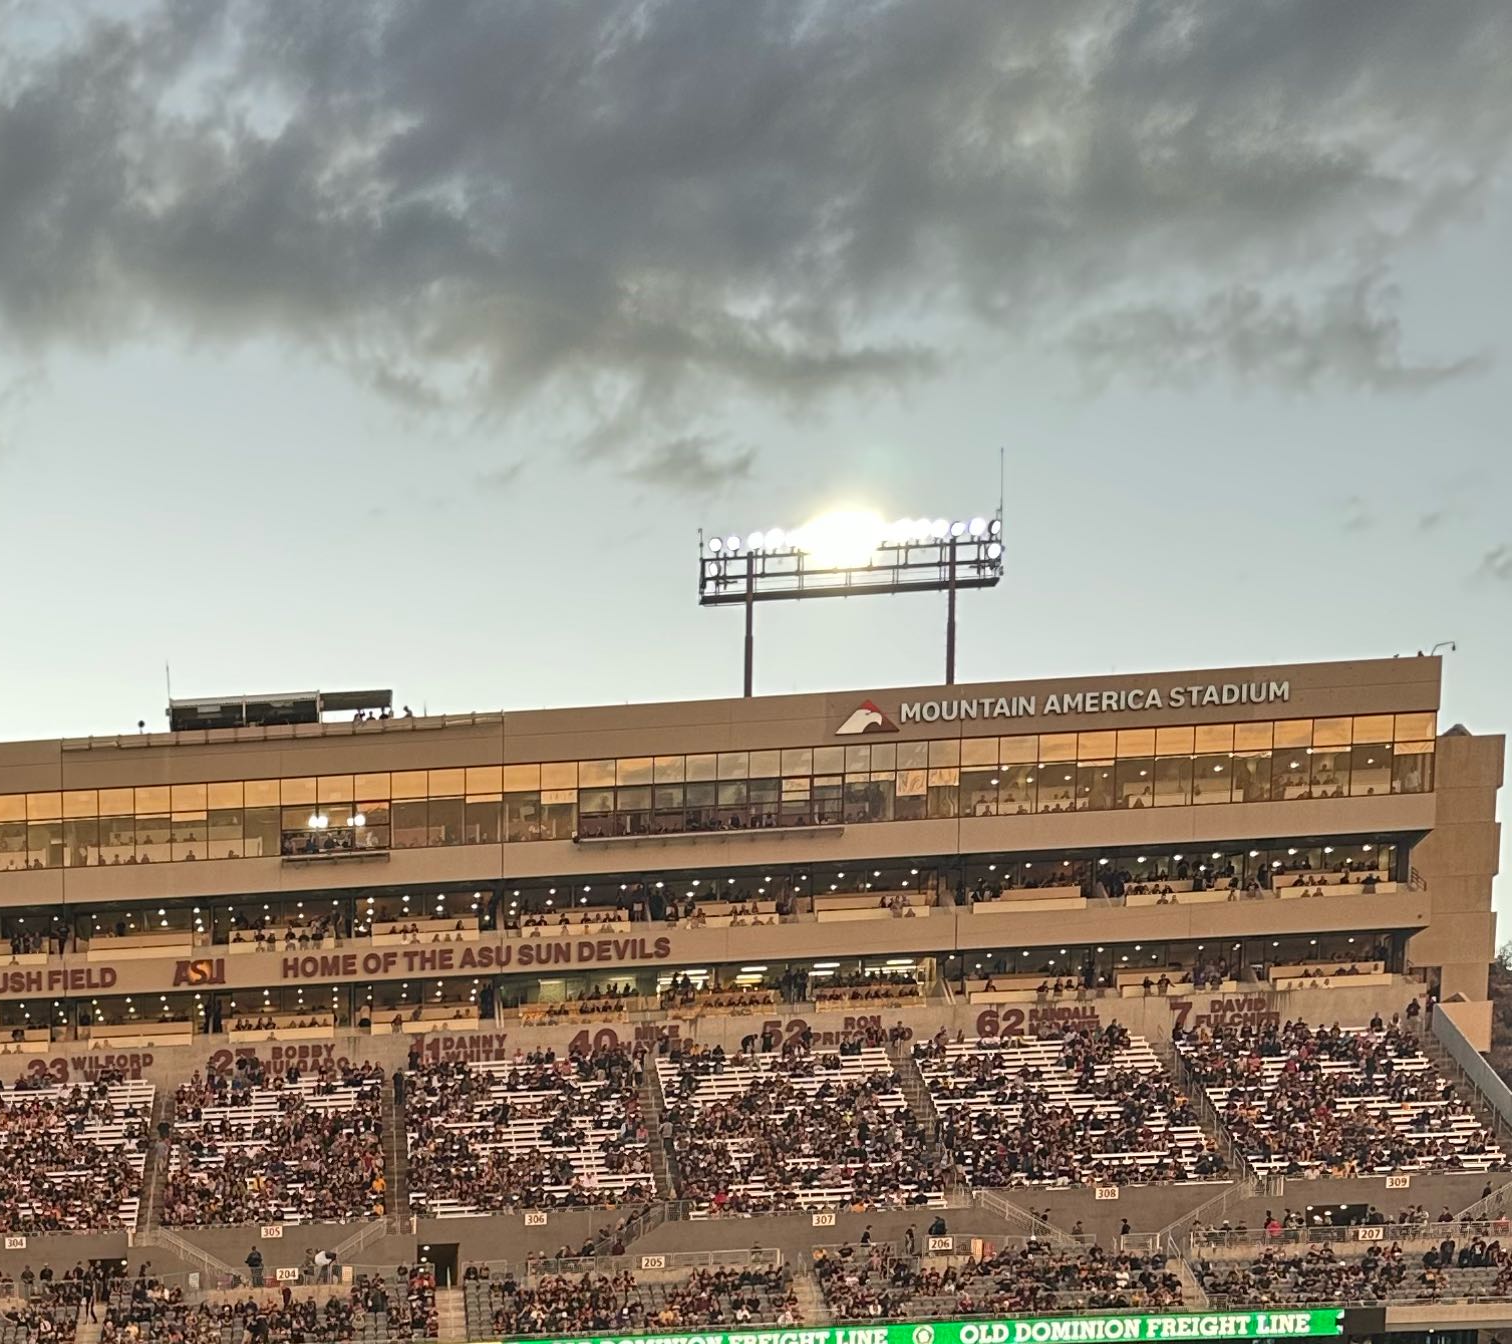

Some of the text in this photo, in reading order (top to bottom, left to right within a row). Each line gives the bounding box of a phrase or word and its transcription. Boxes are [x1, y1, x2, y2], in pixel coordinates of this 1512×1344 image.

[900, 681, 1290, 723] MOUNTAIN AMERICA STADIUM
[282, 937, 671, 979] HOME OF THE ASU SUN DEVILS
[47, 967, 117, 991] FIELD
[173, 958, 226, 986] ASU
[1210, 998, 1266, 1014] DAVID
[976, 1008, 1025, 1038] 62
[443, 1033, 507, 1050] DANNY
[271, 1044, 335, 1059] BOBBY
[71, 1053, 154, 1070] WILFORD
[1389, 1178, 1407, 1186] 309
[1098, 1190, 1116, 1198] 308
[527, 1215, 544, 1223] 306
[816, 1215, 832, 1224] 307
[264, 1228, 280, 1236] 305
[1362, 1230, 1380, 1239] 207
[932, 1239, 949, 1248] 206
[645, 1258, 662, 1267] 205
[279, 1270, 295, 1278] 204
[960, 1313, 1310, 1344] OLD DOMINION FREIGHT LINE
